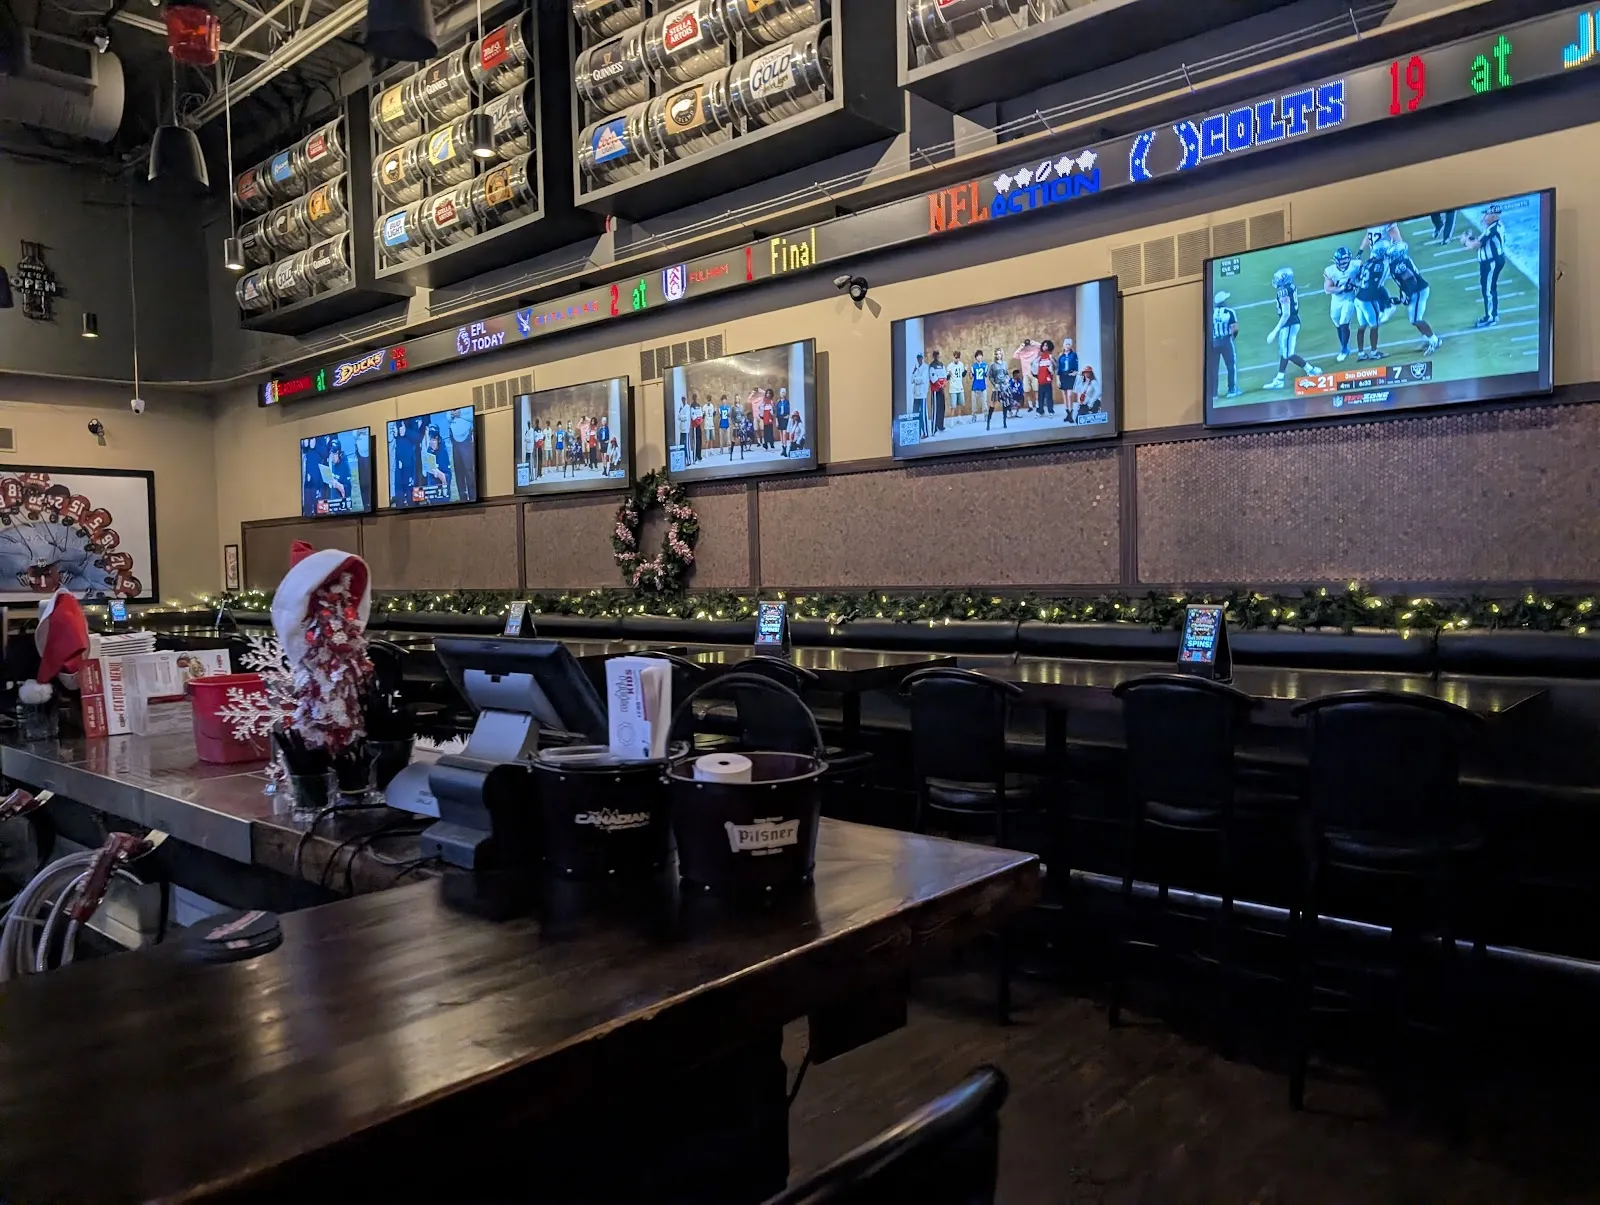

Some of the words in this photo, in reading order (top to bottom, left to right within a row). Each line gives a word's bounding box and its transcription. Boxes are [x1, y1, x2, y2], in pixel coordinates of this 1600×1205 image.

[669, 20, 692, 36] STELLA
[670, 27, 694, 44] ARTOIS
[592, 61, 624, 81] GUINNESS
[752, 54, 791, 92] GOLD
[1389, 55, 1426, 115] 19
[1471, 35, 1512, 93] at
[1200, 79, 1345, 160] COLTS
[927, 180, 989, 234] NFL
[991, 168, 1100, 218] ACTION
[387, 226, 403, 239] LIGHT
[389, 219, 402, 230] BUD
[770, 227, 816, 275] Final
[688, 263, 729, 284] FULHAM
[11, 277, 56, 293] OPEN
[610, 284, 619, 317] 2
[632, 279, 647, 311] at
[470, 322, 487, 336] EPL
[472, 332, 505, 352] TODAY
[340, 352, 383, 383] DUCKS
[976, 368, 985, 380] 12
[1317, 375, 1334, 388] 21
[1356, 369, 1378, 378] DOWN
[1392, 366, 1402, 379] 7
[316, 369, 326, 391] at
[68, 499, 86, 515] 15
[89, 516, 103, 529] 5
[1187, 640, 1213, 649] SPINS!
[108, 662, 122, 683] MENU
[111, 683, 126, 712] FEATURE
[575, 811, 650, 826] CANADIAN
[739, 828, 794, 844] Pilsner
